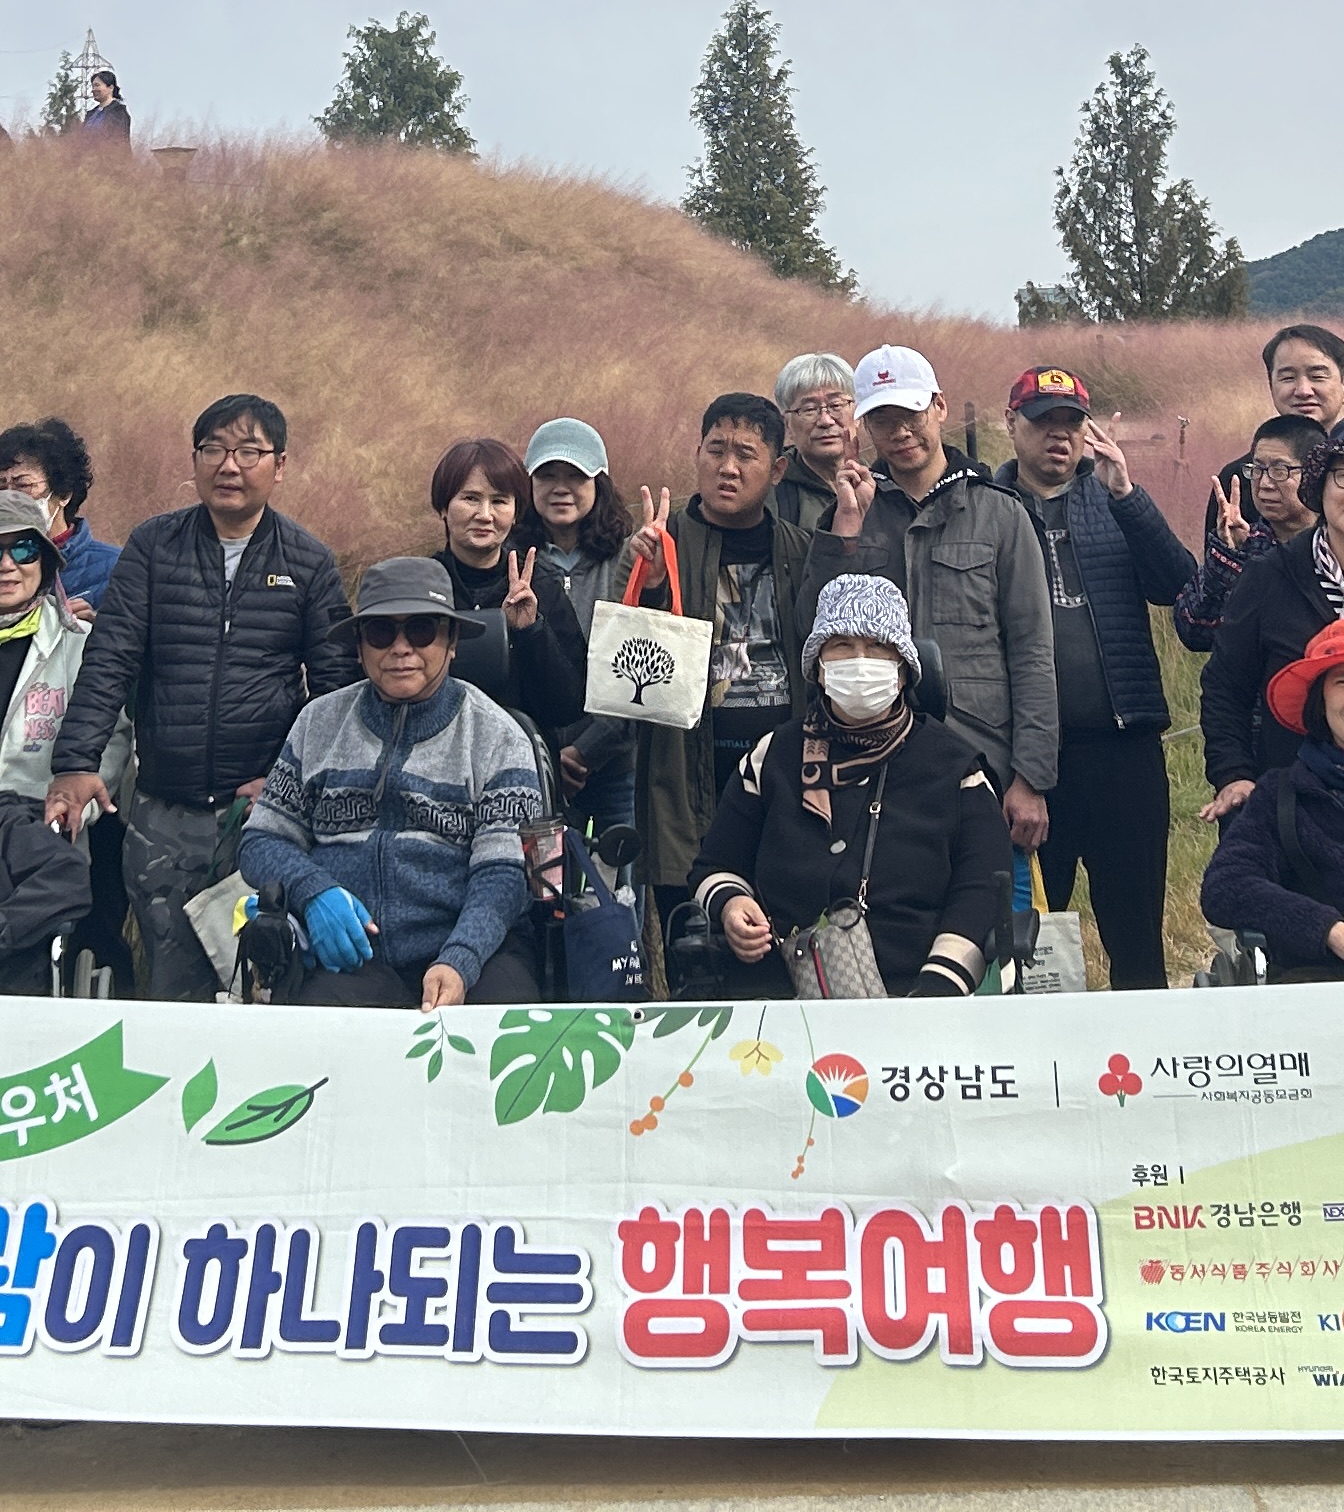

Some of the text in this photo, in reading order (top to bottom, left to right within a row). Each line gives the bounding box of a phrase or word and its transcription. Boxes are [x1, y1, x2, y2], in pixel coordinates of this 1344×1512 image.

[881, 1063, 1019, 1102] 경상남도
[1150, 1051, 1312, 1088] 사랑의열매
[1200, 1088, 1313, 1105] 사회복지공동모금회
[1131, 1164, 1169, 1187] 후원
[1133, 1200, 1303, 1230] BNK 경남은행
[180, 1221, 585, 1359] 하나되는
[616, 1203, 1099, 1361] 행복여행
[1150, 1365, 1286, 1387] 한국토지주택공사
